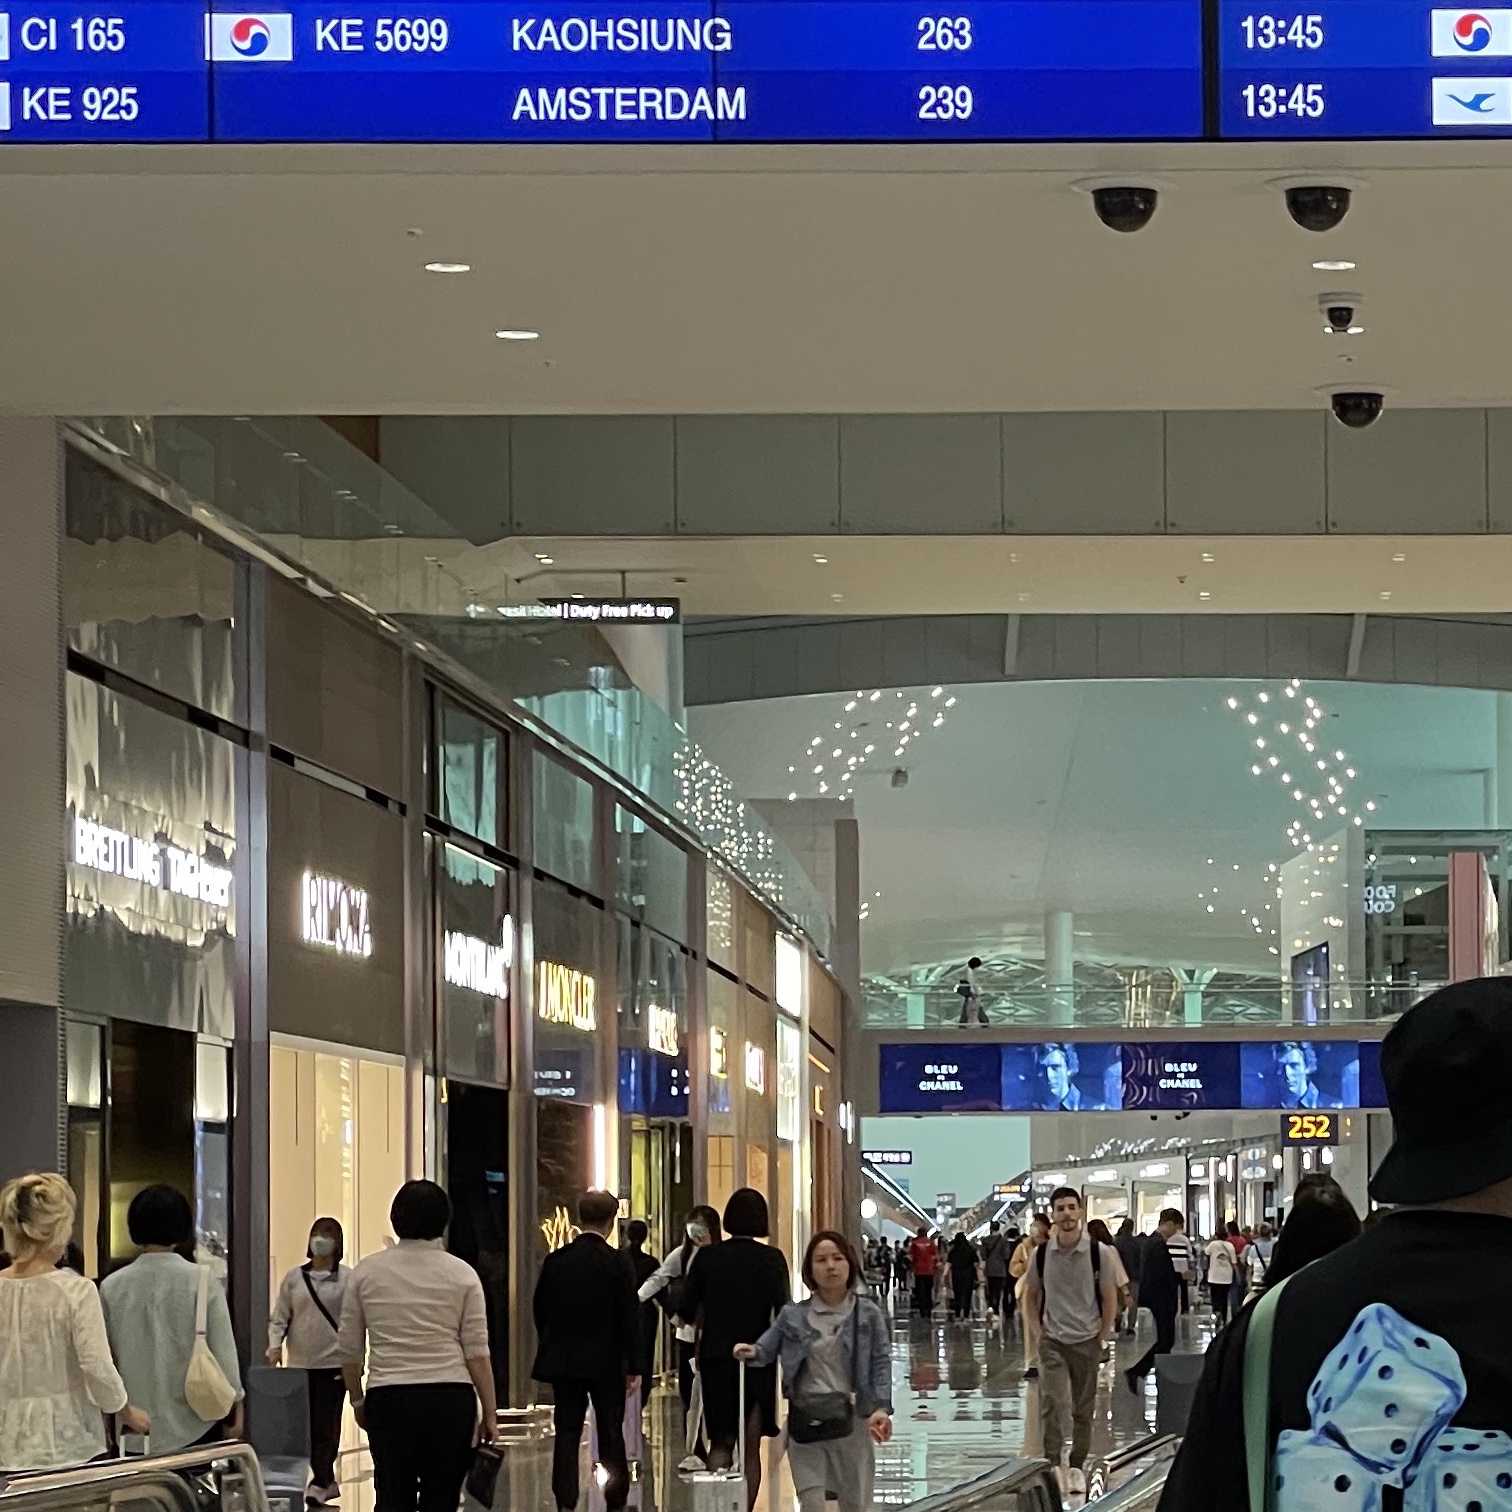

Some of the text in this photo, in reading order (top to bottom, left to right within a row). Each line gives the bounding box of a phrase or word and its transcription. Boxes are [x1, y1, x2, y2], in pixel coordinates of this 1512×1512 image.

[21, 17, 126, 51] CI 165
[315, 18, 448, 52] KE 5699
[512, 17, 732, 52] KAOHSIUNG
[917, 16, 972, 51] 263
[1241, 14, 1324, 49] 13:45
[22, 86, 139, 121] KE 925
[512, 86, 747, 121] AMSTERDAM
[918, 85, 973, 120] 239
[1242, 83, 1325, 118] 13:45
[75, 816, 161, 887] BREITLING
[918, 1080, 964, 1091] CHANEL
[1158, 1078, 1203, 1089] CHANEL
[1287, 1114, 1331, 1139] 252
